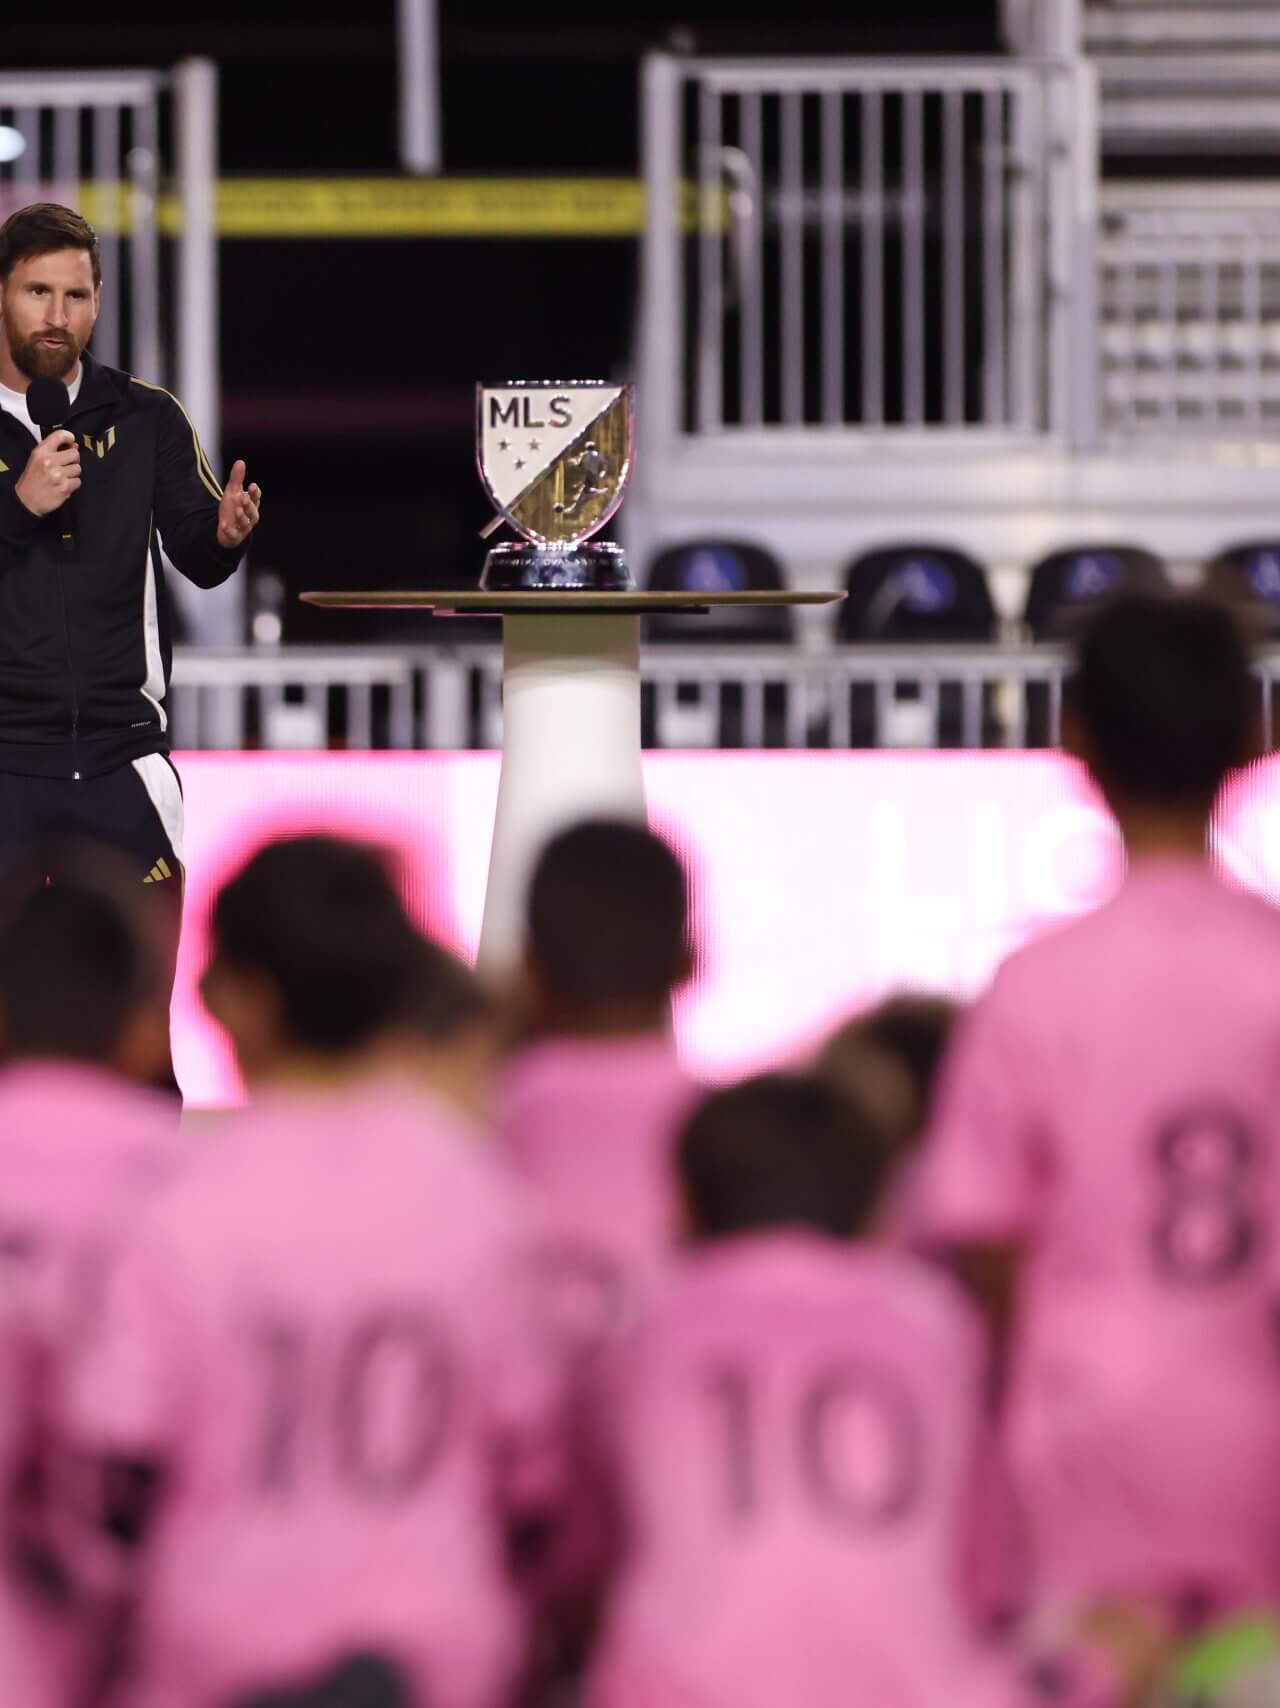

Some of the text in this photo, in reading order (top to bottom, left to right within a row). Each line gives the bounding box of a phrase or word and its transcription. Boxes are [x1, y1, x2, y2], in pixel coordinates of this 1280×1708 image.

[490, 396, 572, 428] MLS
[1150, 1104, 1257, 1290] 8
[248, 1302, 460, 1500] 10
[705, 1358, 925, 1527] 10
